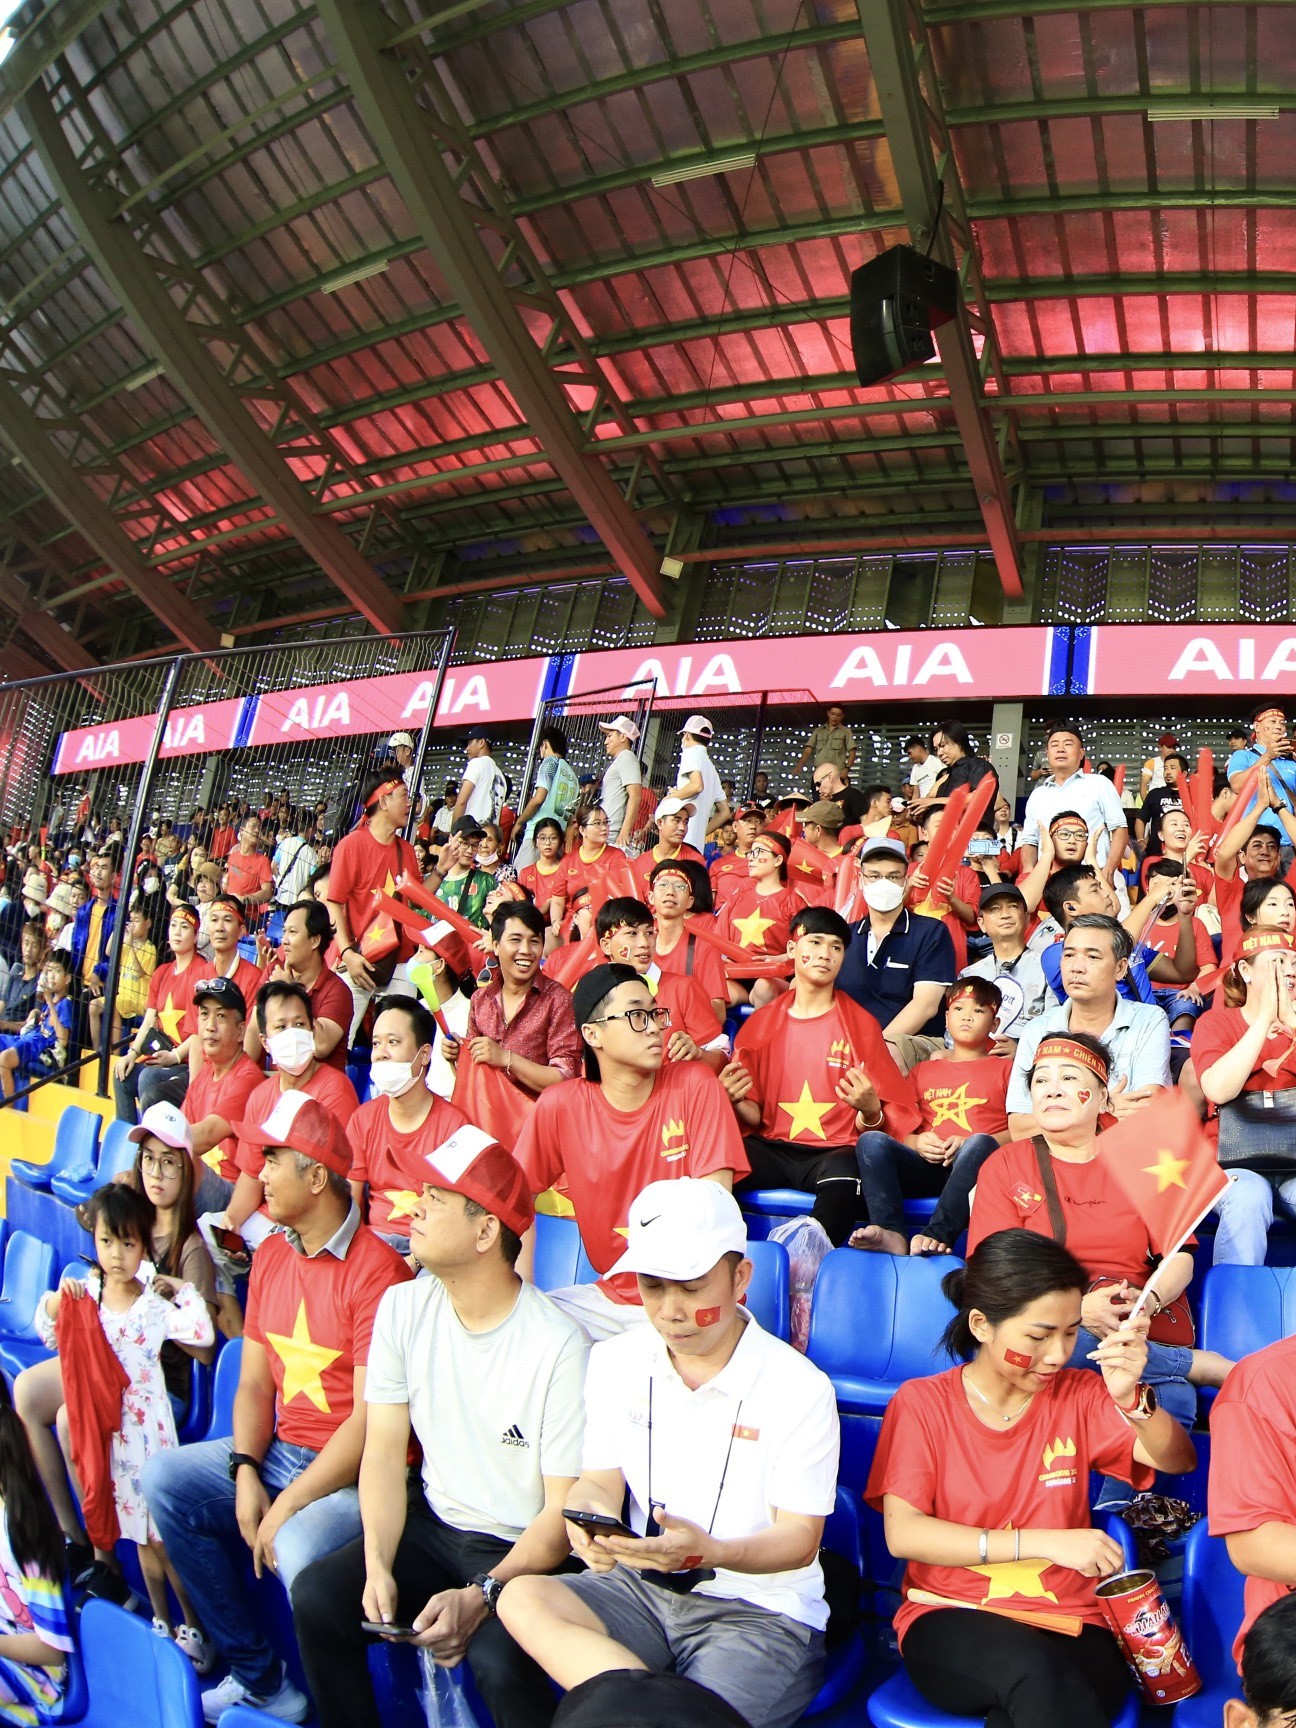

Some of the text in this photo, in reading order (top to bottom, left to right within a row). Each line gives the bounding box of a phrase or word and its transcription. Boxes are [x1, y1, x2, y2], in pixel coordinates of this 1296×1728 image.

[623, 653, 743, 699] AIA
[830, 642, 975, 688] AIA
[401, 674, 491, 719] AIA
[281, 692, 351, 732] AIA
[75, 729, 119, 763] AIA
[1242, 934, 1282, 951] VIỆT NAM
[1042, 1045, 1061, 1057] NAM
[1073, 1046, 1097, 1070] CHIẾN
[923, 1087, 953, 1101] VIỆT NAM
[502, 1437, 530, 1449] adidas
[1127, 1593, 1146, 1604] PRAWN
